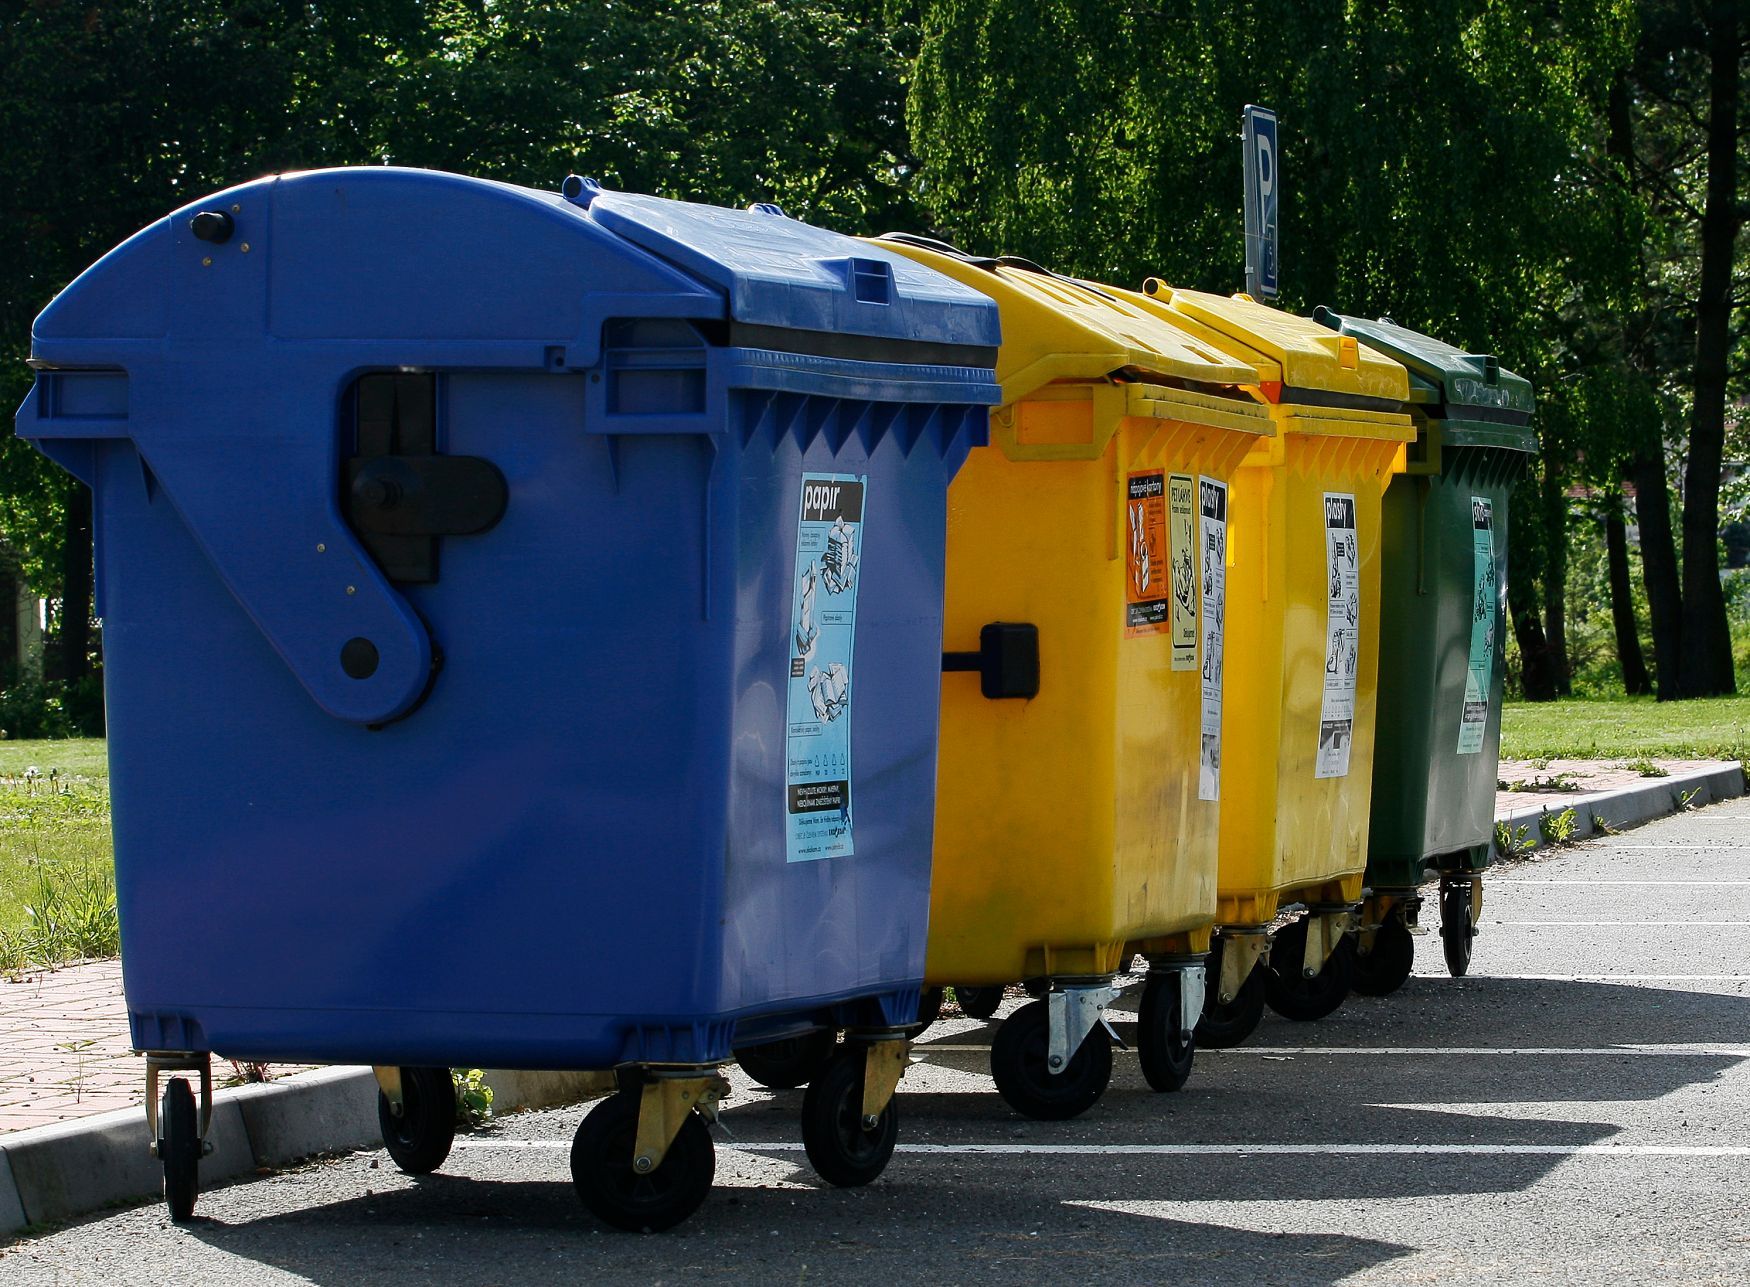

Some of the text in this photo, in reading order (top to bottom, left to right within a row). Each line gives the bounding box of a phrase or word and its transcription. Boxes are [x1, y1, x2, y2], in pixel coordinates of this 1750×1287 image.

[1257, 133, 1272, 234] P
[1201, 483, 1220, 519] plasty
[1326, 497, 1347, 529] plasty
